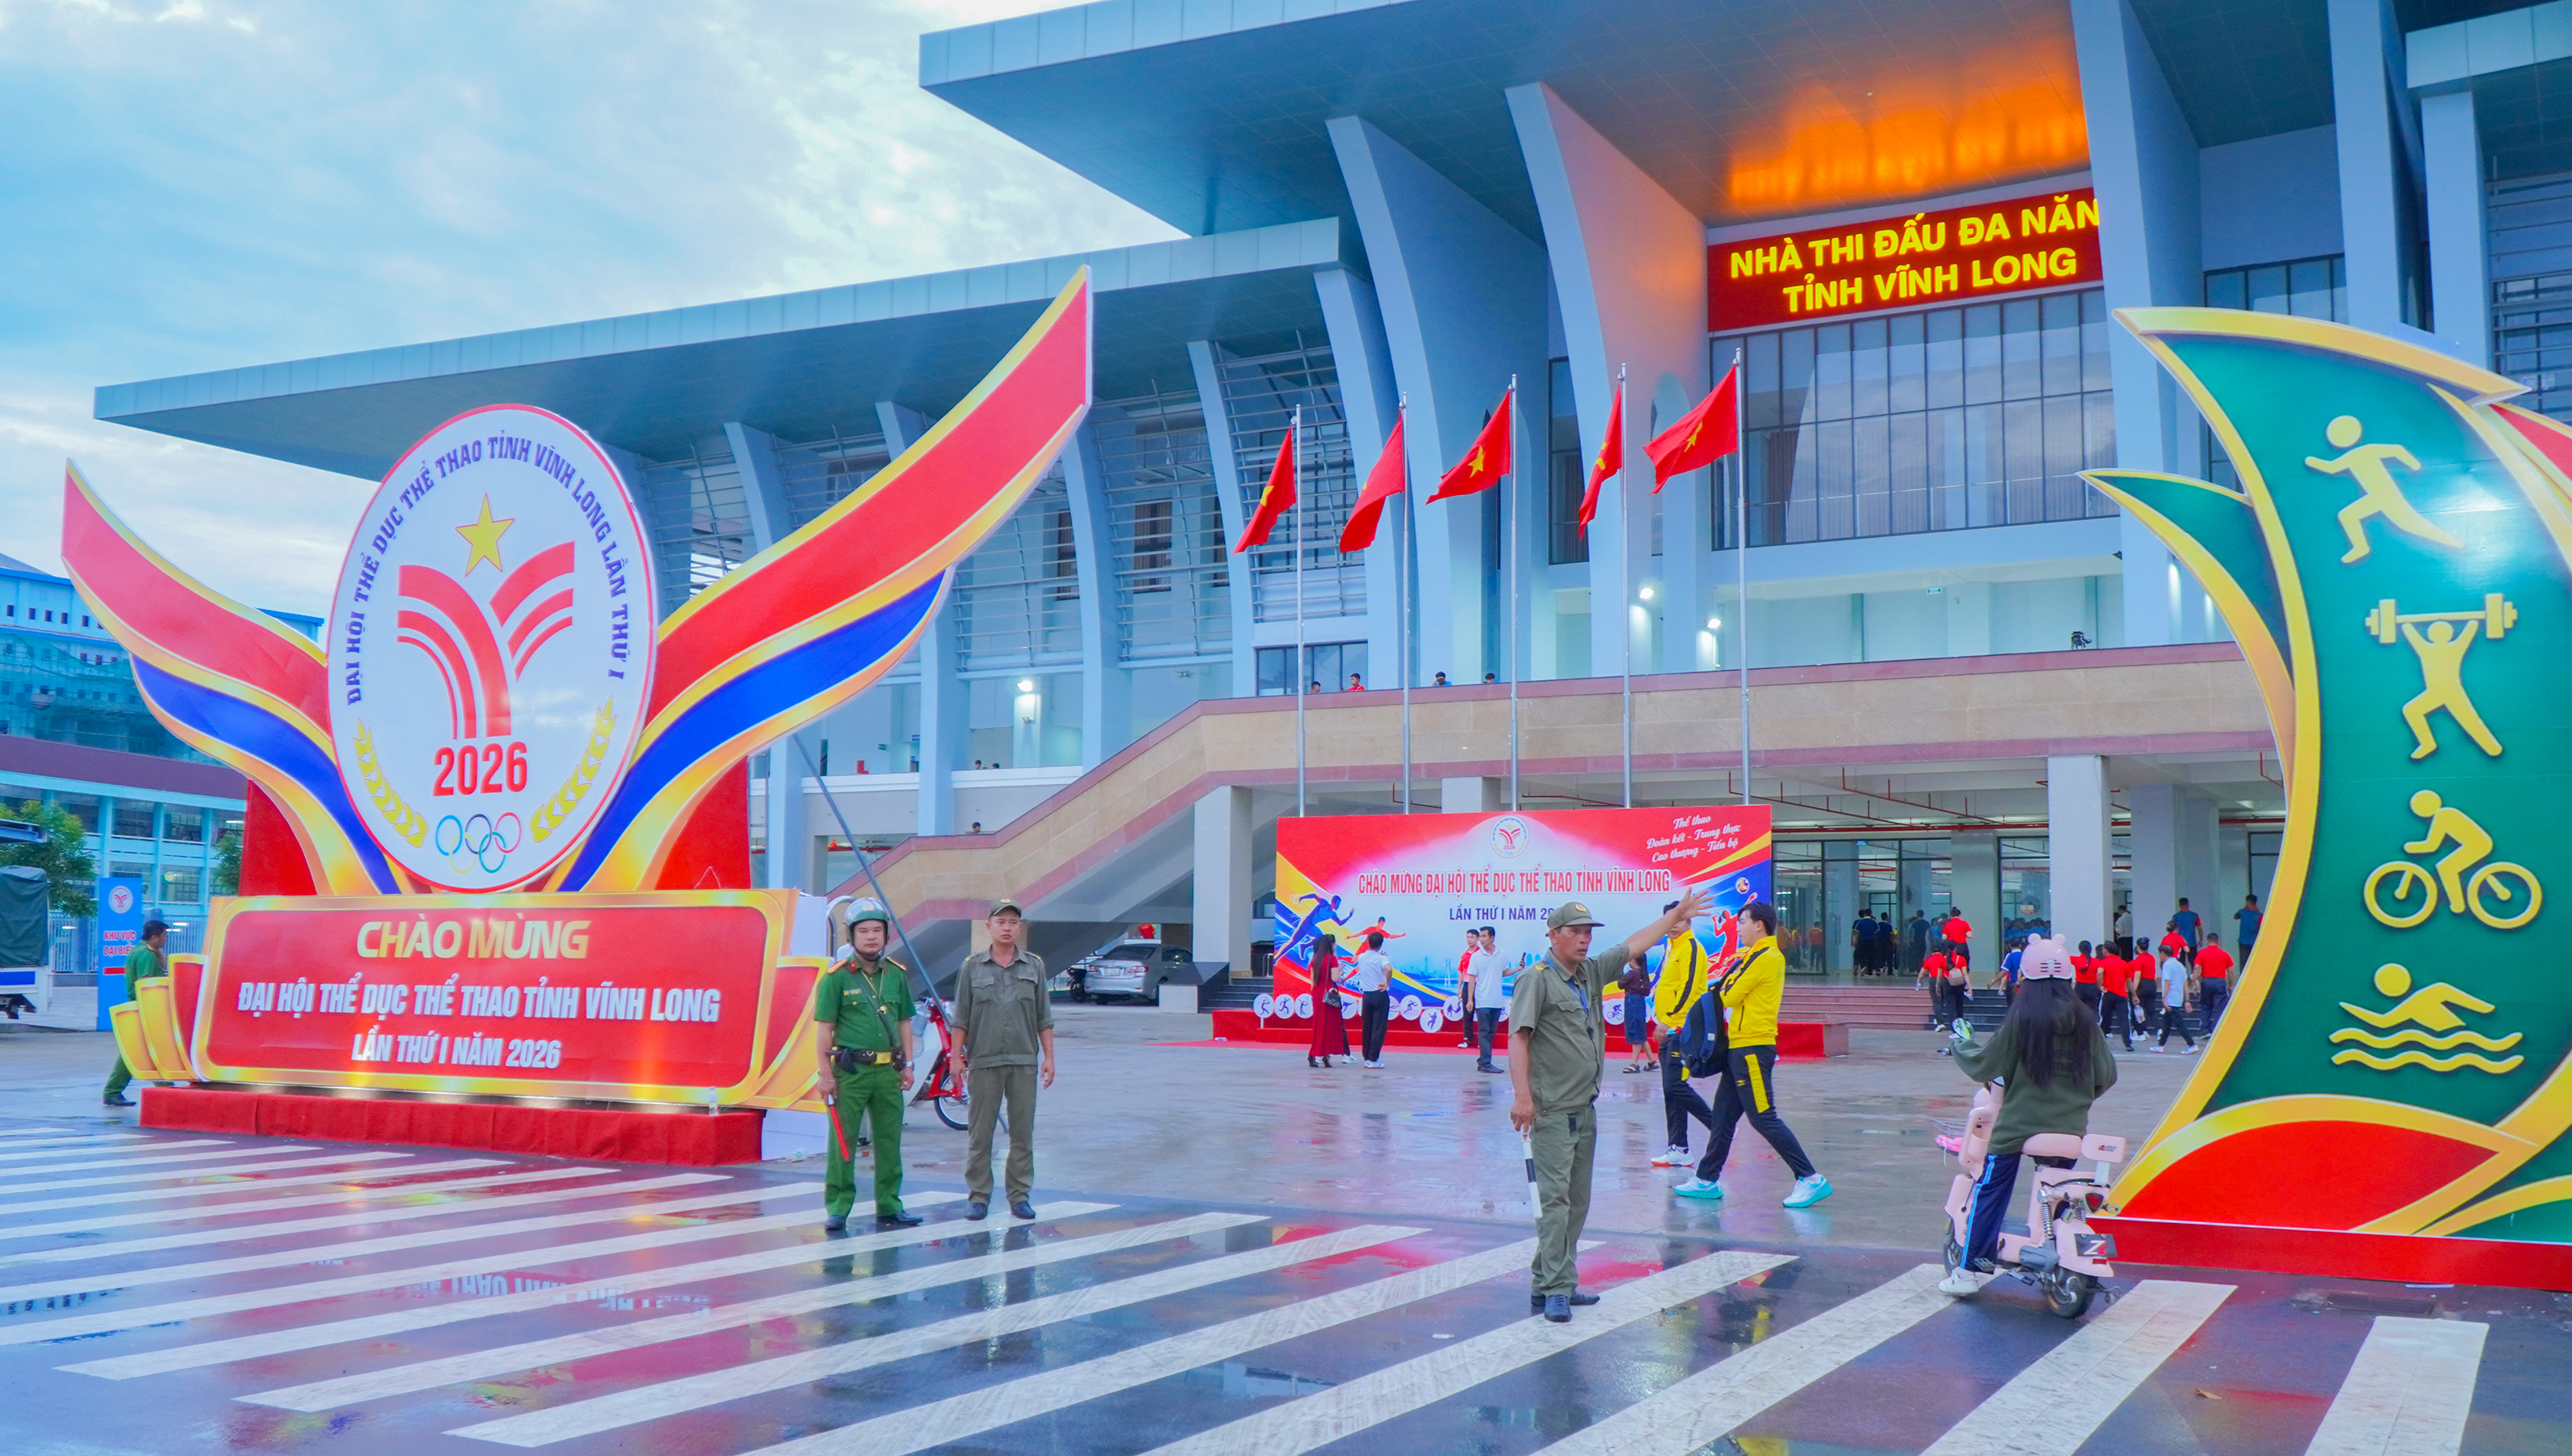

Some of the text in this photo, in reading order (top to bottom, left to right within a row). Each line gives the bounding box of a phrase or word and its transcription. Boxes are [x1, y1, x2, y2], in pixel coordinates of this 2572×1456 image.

[1730, 193, 2100, 279] NHÀ THI ĐẤU ĐA NĂN
[1782, 247, 2077, 313] TỈNH VĨNH LONG
[345, 430, 631, 706] ĐẠI HỘI THỂ DỤC THỂ THAO TỈNH VĨNH LONG LẦN THỨ I
[432, 741, 528, 797] 2026
[1646, 836, 1670, 849] Đoàn
[1672, 832, 1685, 844] kết
[1694, 828, 1721, 840] Trung
[1722, 823, 1741, 835] thực
[1673, 815, 1711, 830] Thể thao
[1651, 851, 1668, 863] Cao
[1707, 839, 1726, 853] Tiến
[1727, 836, 1739, 849] bộ
[1358, 863, 1671, 898] CHÀO MỪNG ĐẠI HỘI THỂ DỤC THỂ THAO TỈNH VĨNH LONG
[1449, 904, 1472, 921] LẦN
[1475, 904, 1499, 921] THỨ
[1501, 908, 1505, 921] I
[1508, 905, 1536, 921] NĂM
[104, 931, 120, 941] KHU
[118, 942, 133, 956] BIỂ
[357, 912, 591, 959] CHÀO MỪNG
[237, 971, 721, 1022] ĐẠI HỘI THỂ DỤC THỂ THAO TỈNH VĨNH LONG
[350, 1024, 562, 1069] LẦN THỨ I NĂM 2026
